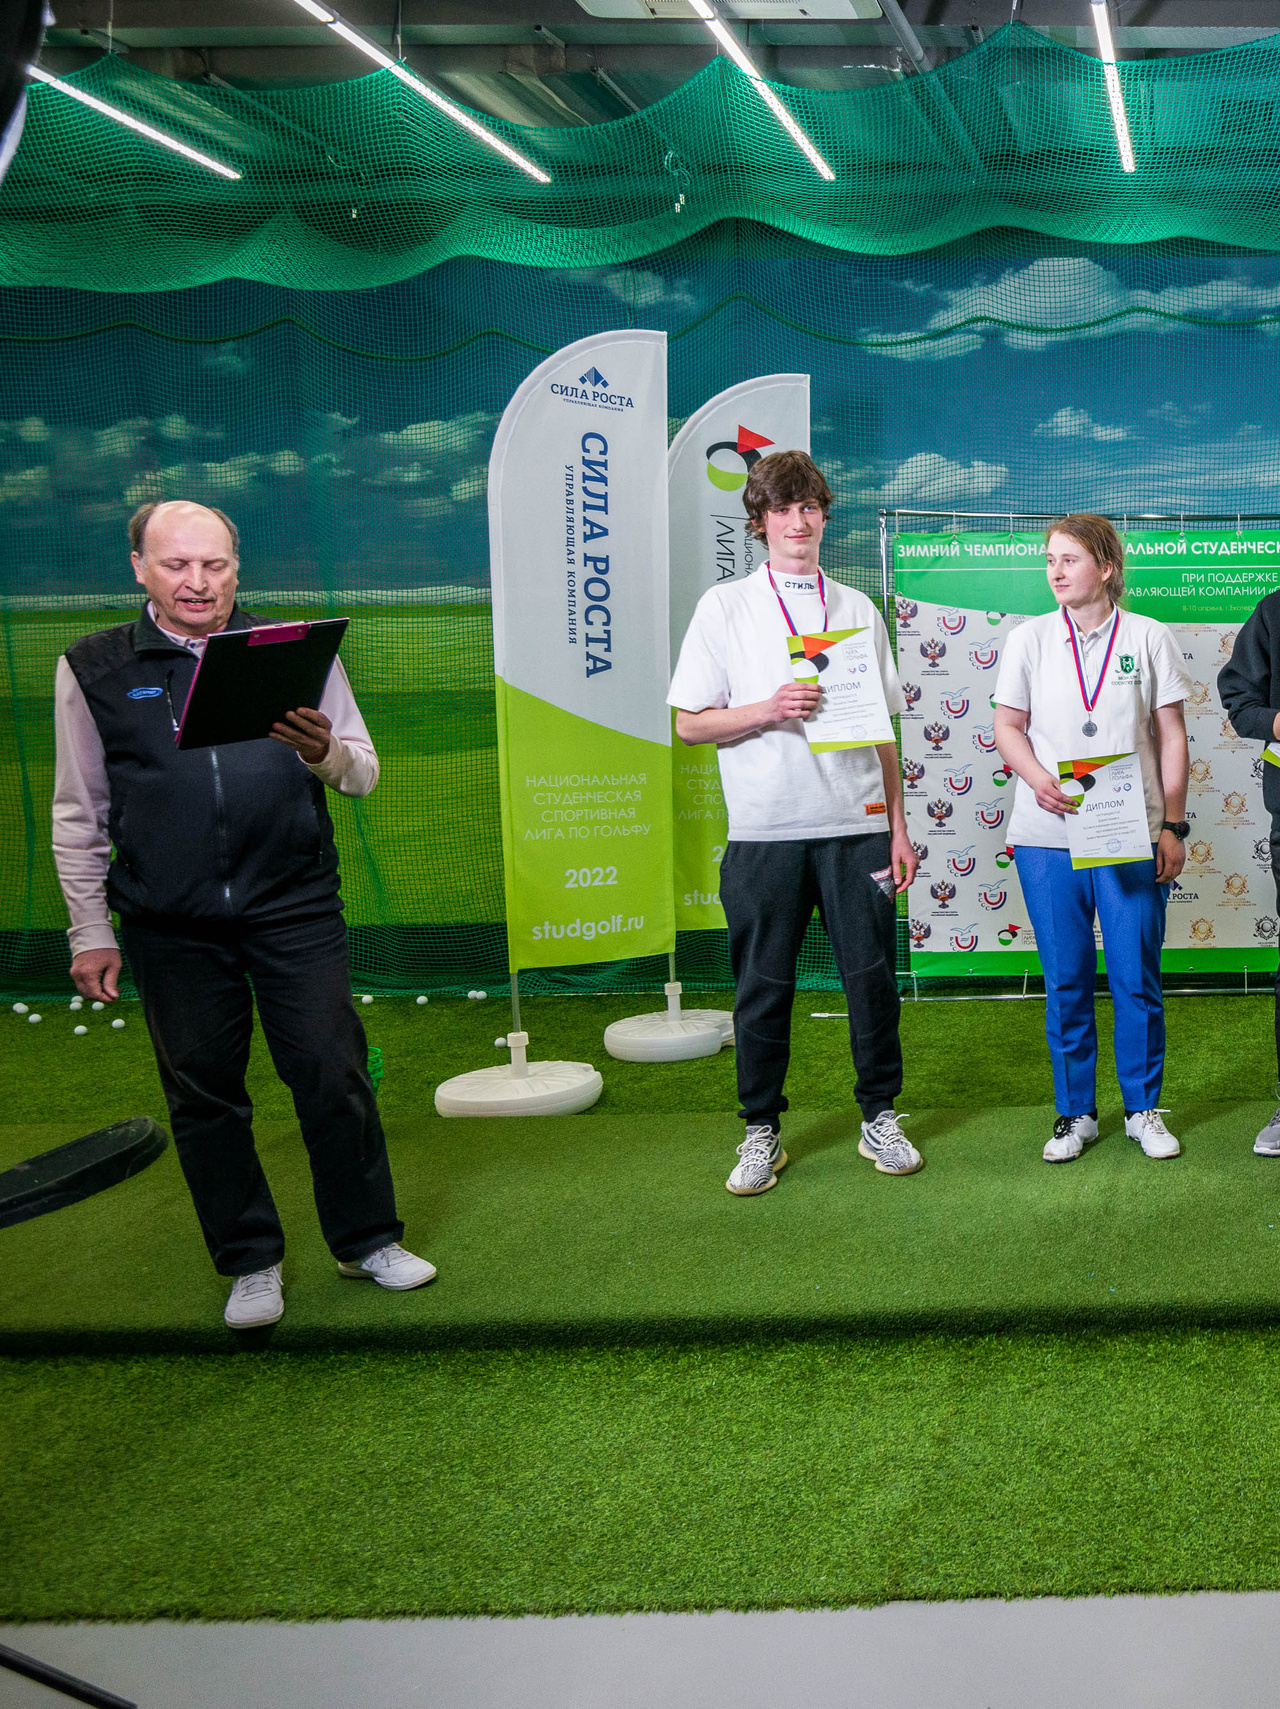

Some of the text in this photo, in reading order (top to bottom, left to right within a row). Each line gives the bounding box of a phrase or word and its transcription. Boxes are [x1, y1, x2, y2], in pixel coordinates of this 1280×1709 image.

[550, 383, 634, 408] СИЛА РОСТА
[564, 465, 578, 644] УПРАВЛЯЮЩАЯ КОМПАНИЯ
[581, 431, 613, 678] СИЛА РОСТА
[716, 520, 735, 581] ЛИГА
[897, 541, 960, 558] ЗИМНИЙ
[963, 543, 1047, 557] ЧЕМПИОНА
[1125, 540, 1187, 555] АЛЬНОЙ
[784, 581, 815, 590] СТИЛЬ
[1181, 572, 1278, 584] ПРИ ПОДДЕРЖКЕ
[1198, 586, 1266, 597] КОМПАНИИ
[525, 773, 647, 789] НАЦИОНАЛЬНАЯ
[533, 790, 642, 807] СТУДЕНЧЕСКАЯ
[1086, 799, 1125, 813] ДИПЛОМ
[541, 807, 636, 824] СПОРТИВНАЯ
[679, 808, 715, 821] ЛИГА
[523, 823, 651, 842] ЛИГА ПО ГОЛЬФУ
[564, 866, 618, 890] 2022
[1172, 892, 1199, 900] РОСТА
[531, 914, 645, 942] studgolf.ru
